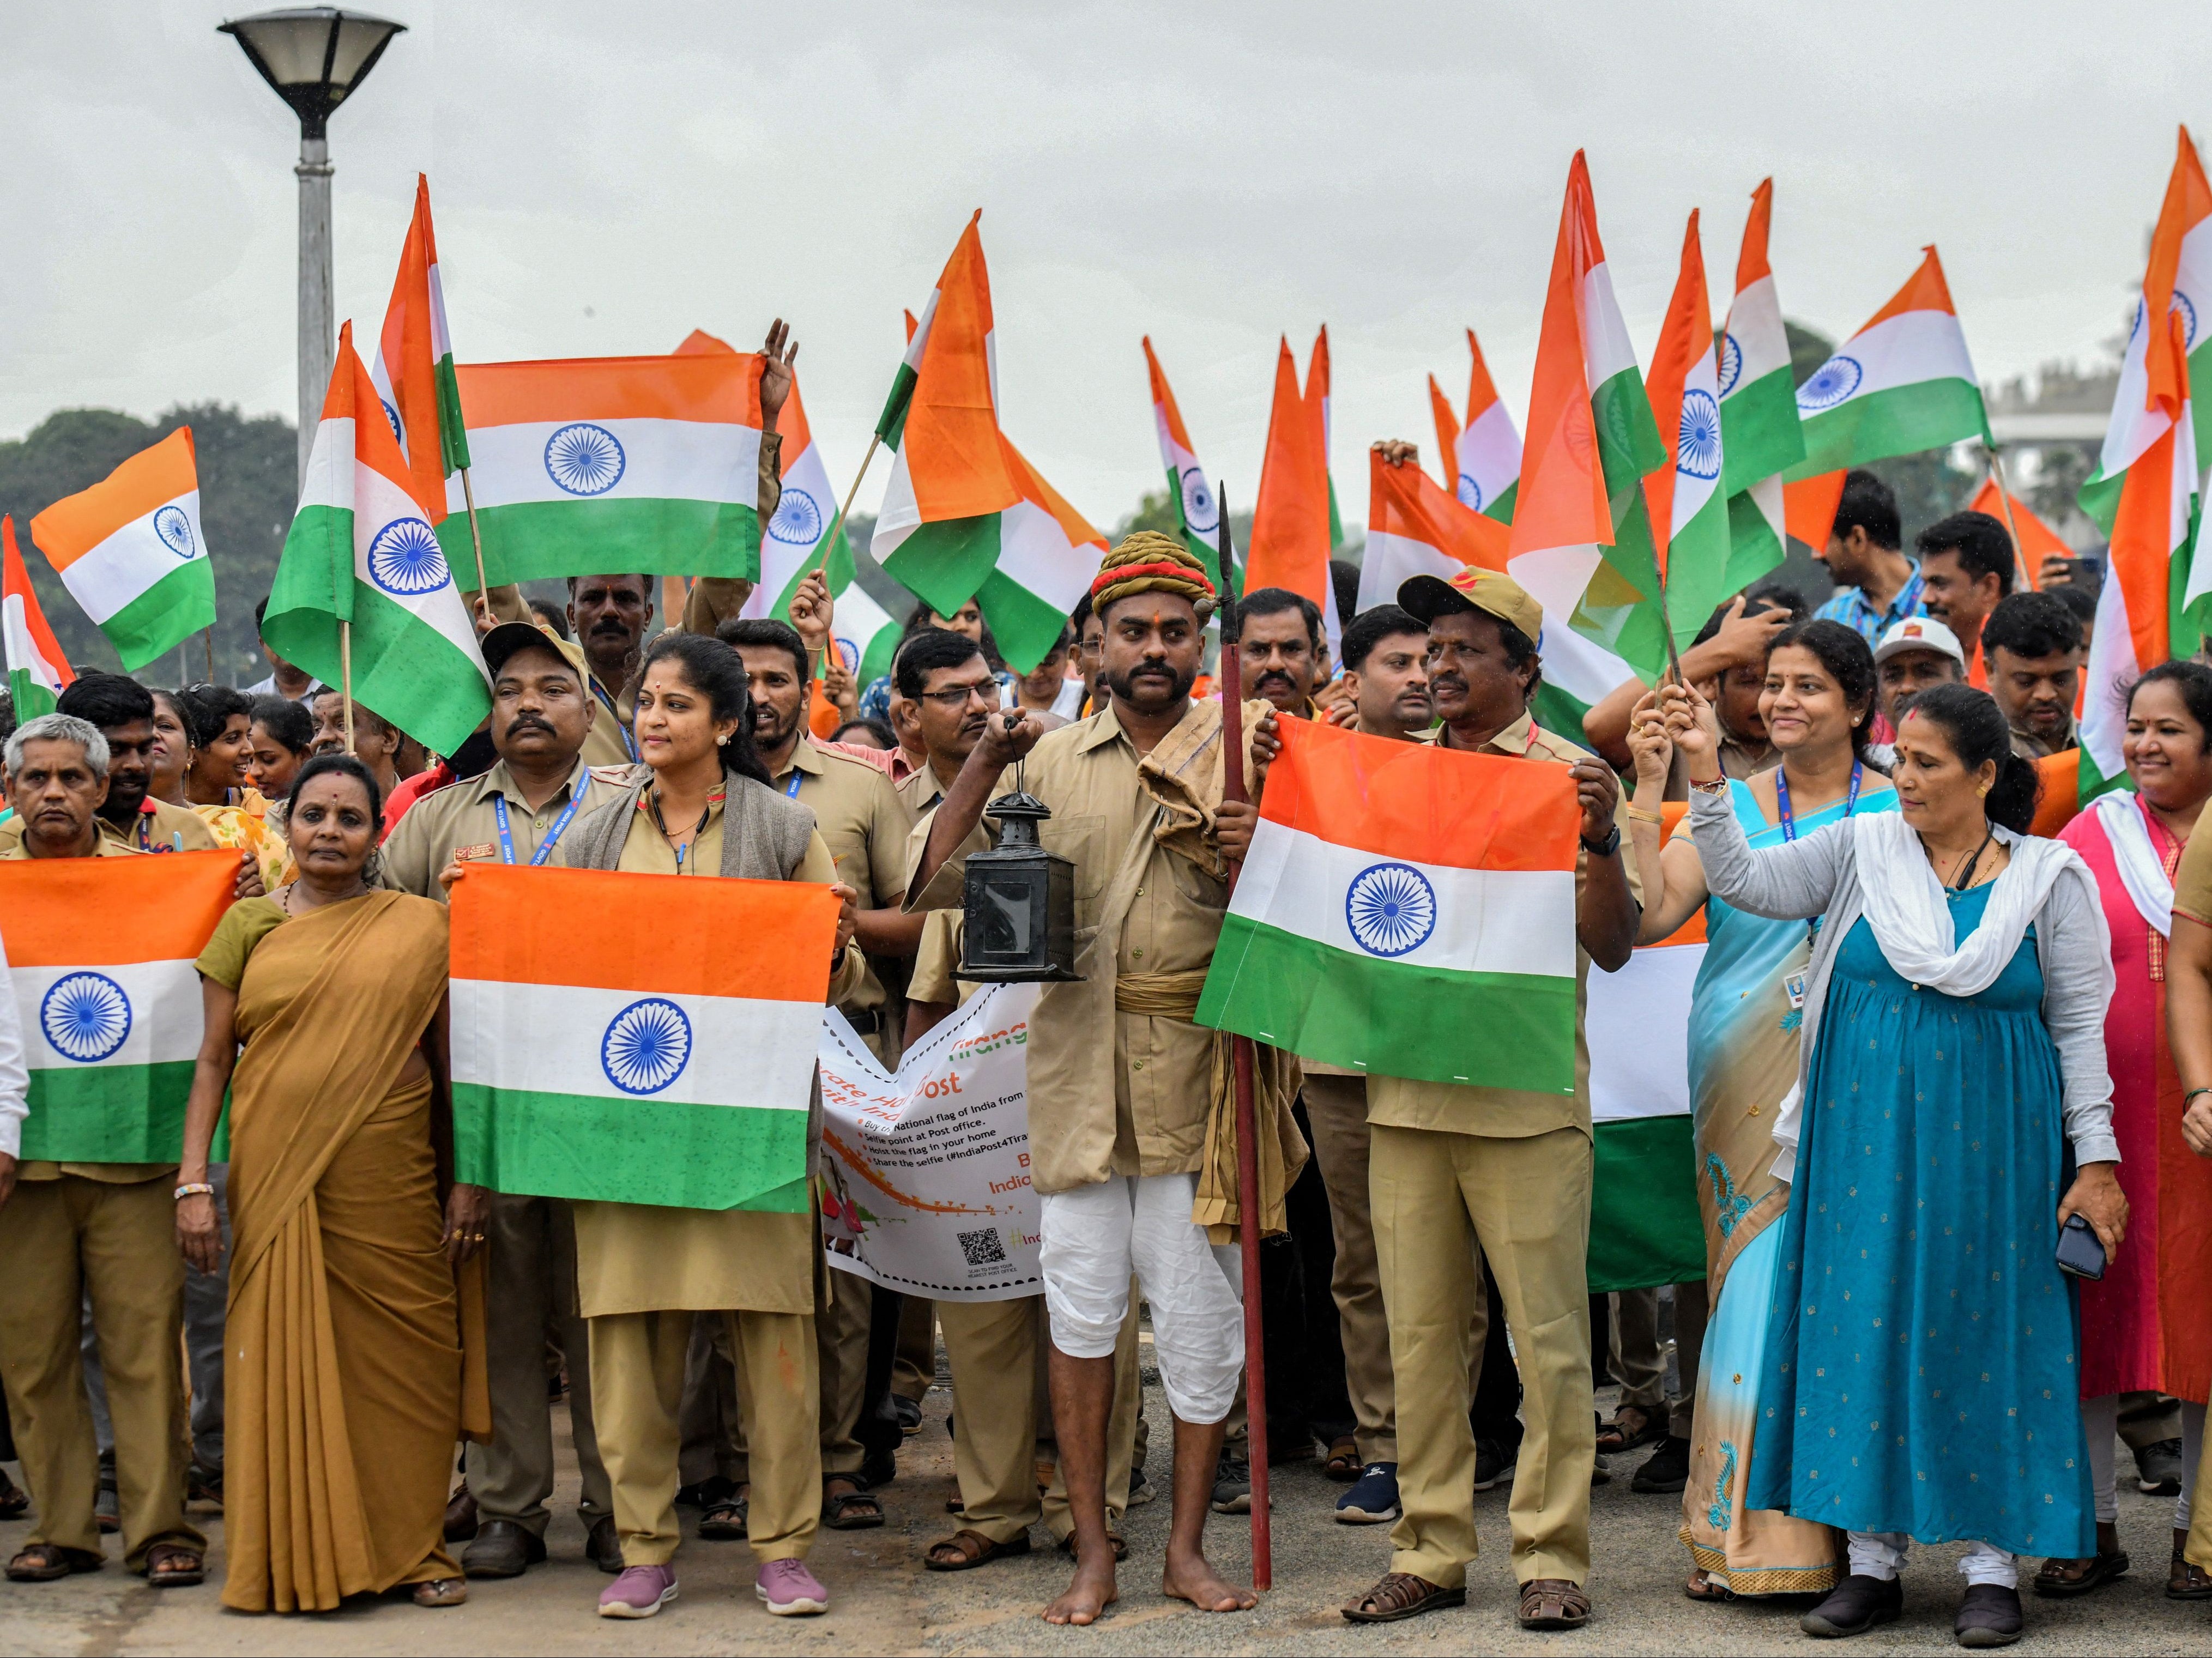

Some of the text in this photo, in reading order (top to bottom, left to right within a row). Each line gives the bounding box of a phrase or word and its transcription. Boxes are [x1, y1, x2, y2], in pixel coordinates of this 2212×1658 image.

[789, 779, 798, 793] INDIA
[553, 809, 572, 835] INDIA POST
[819, 1065, 867, 1098] rate
[865, 1121, 881, 1131] Buy
[894, 1116, 934, 1131] National
[936, 1112, 956, 1122] flag
[958, 1107, 968, 1117] of
[971, 1101, 996, 1114] India
[998, 1092, 1023, 1105] from
[865, 1120, 986, 1146] Selfie point at Post office.
[868, 1146, 889, 1155] Hoist
[908, 1146, 928, 1155] flag
[942, 1137, 965, 1150] your
[968, 1129, 996, 1142] home
[873, 1133, 1029, 1167] Share the selfie (#IndiaPost4Tira
[989, 1175, 1031, 1194] India
